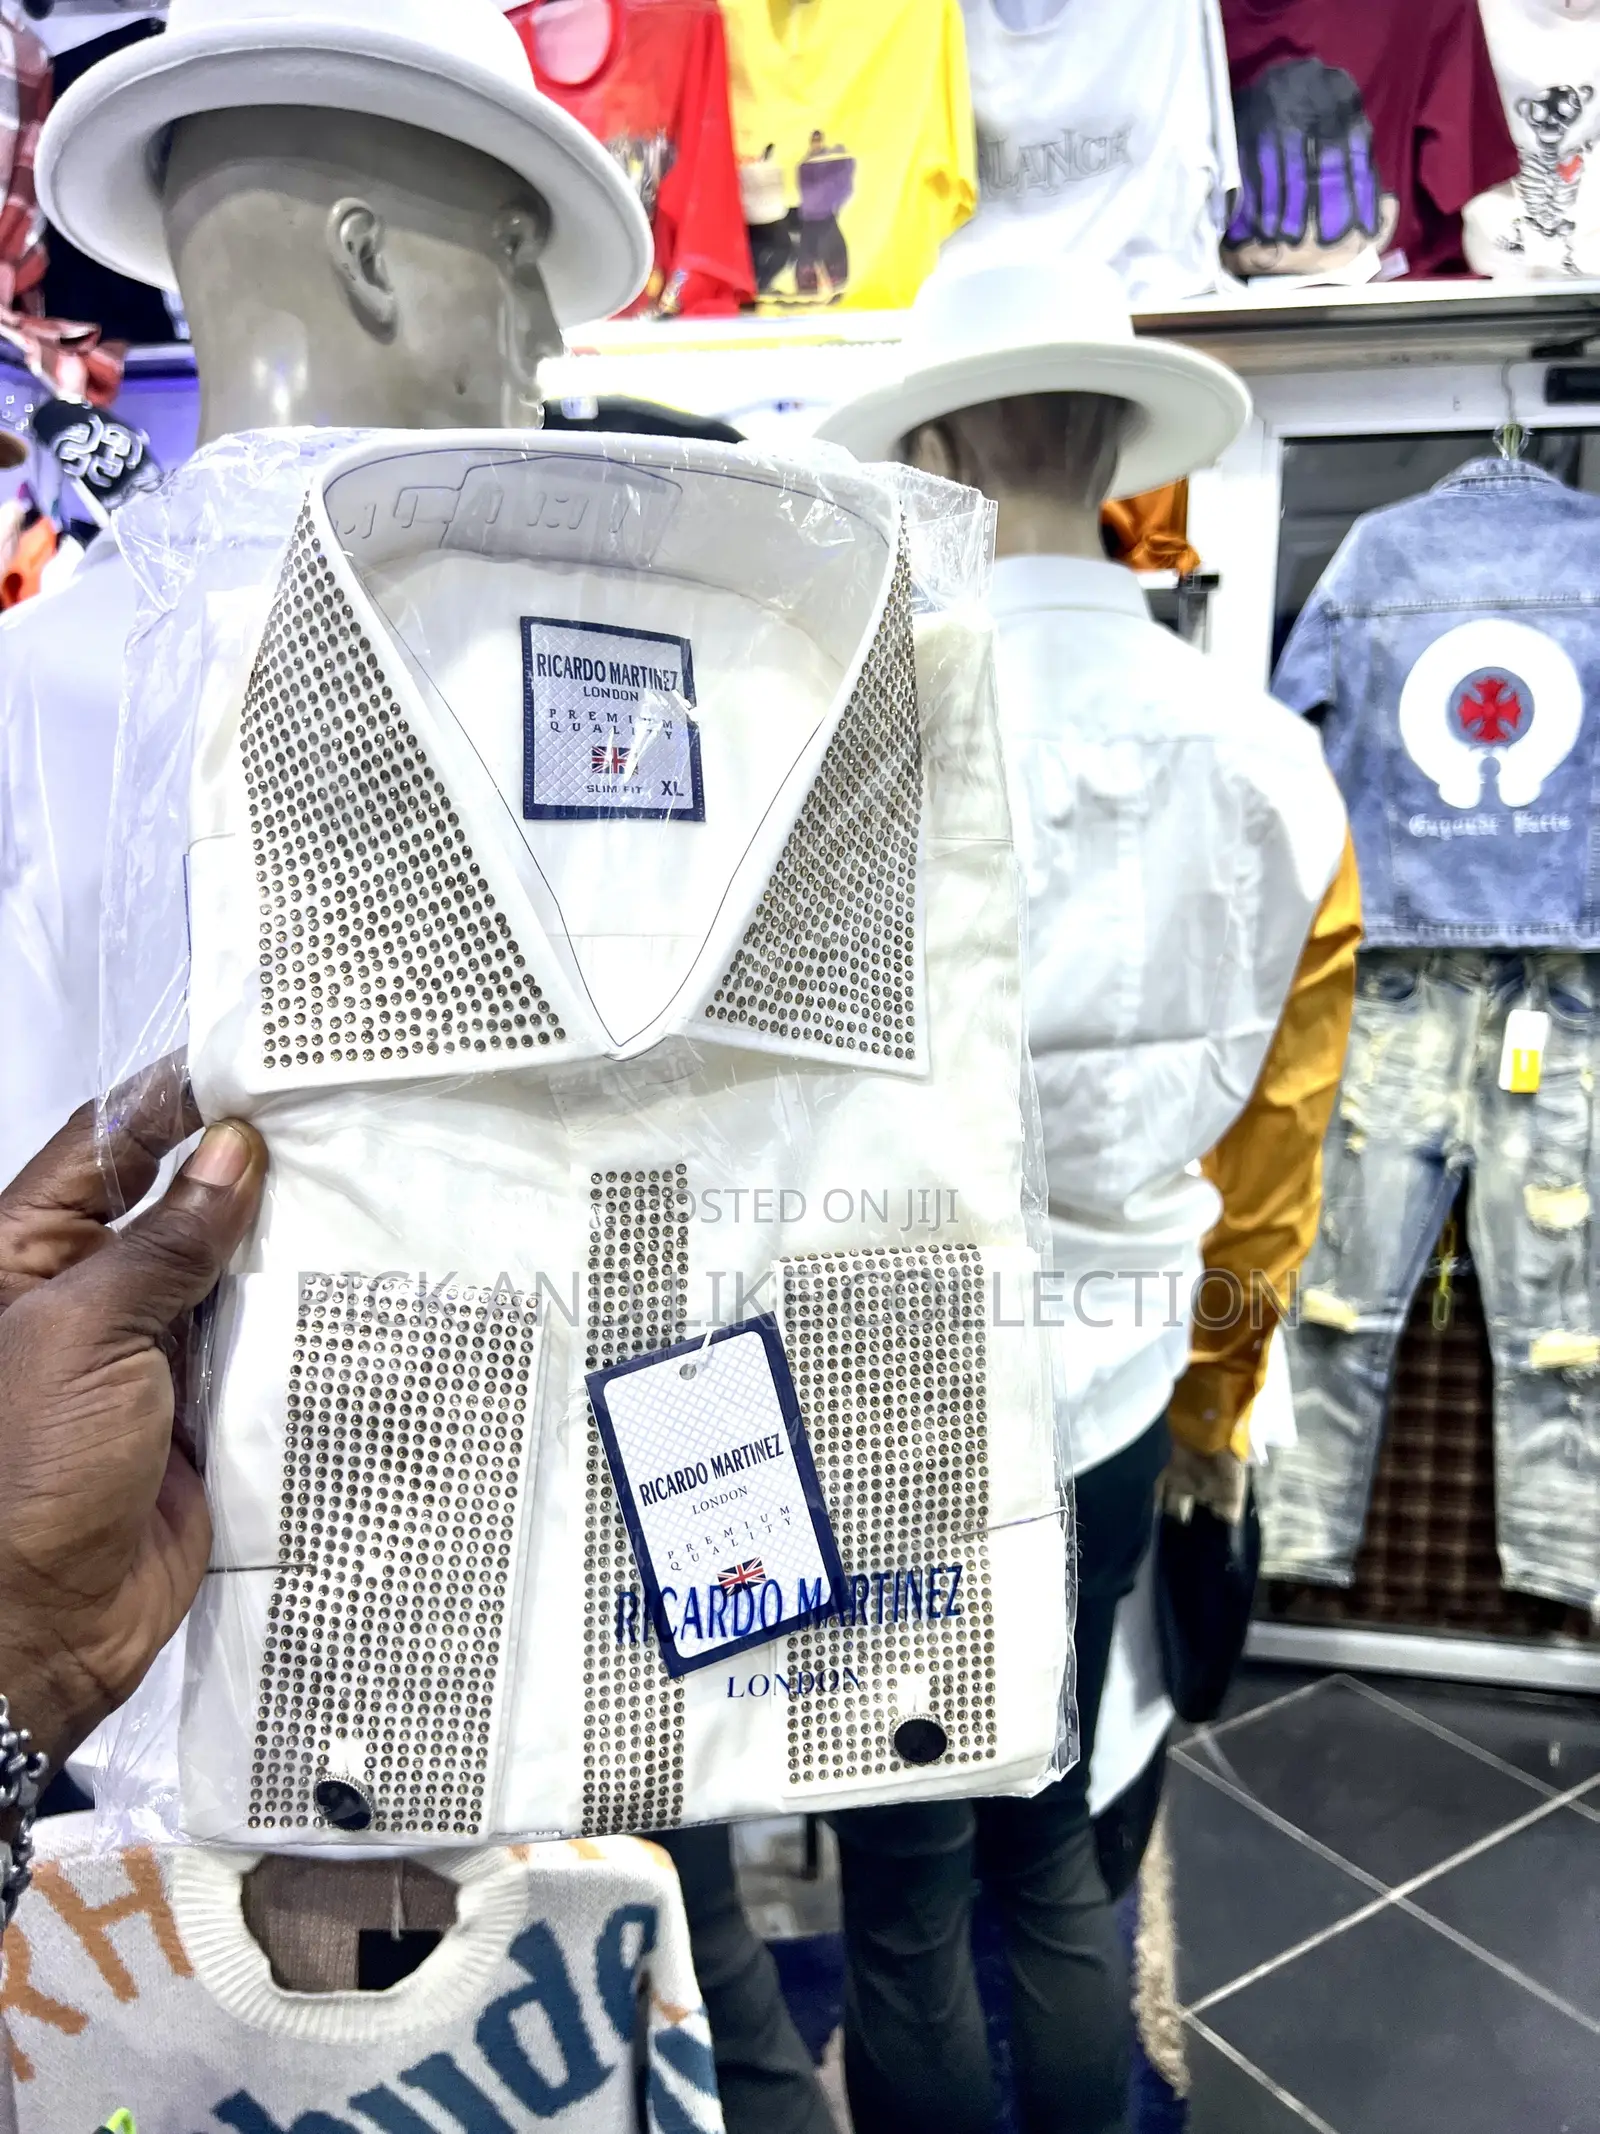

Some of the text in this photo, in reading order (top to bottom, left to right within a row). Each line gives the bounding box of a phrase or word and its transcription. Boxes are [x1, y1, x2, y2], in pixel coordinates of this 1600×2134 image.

[536, 653, 678, 691] RICARDO MARTINEZ
[583, 686, 639, 701] LONDON
[549, 708, 673, 729] PREMIM
[586, 784, 643, 794] SLIM FIT
[661, 780, 684, 797] XL
[639, 1433, 784, 1507] RICARDO MARTINEZ
[692, 1485, 749, 1515] LONDON
[667, 1505, 791, 1560] PREMIUM
[670, 1517, 793, 1572] QUALITY
[617, 1565, 964, 1644] RICARDO MARTINEZ
[727, 1667, 864, 1698] LONDON
